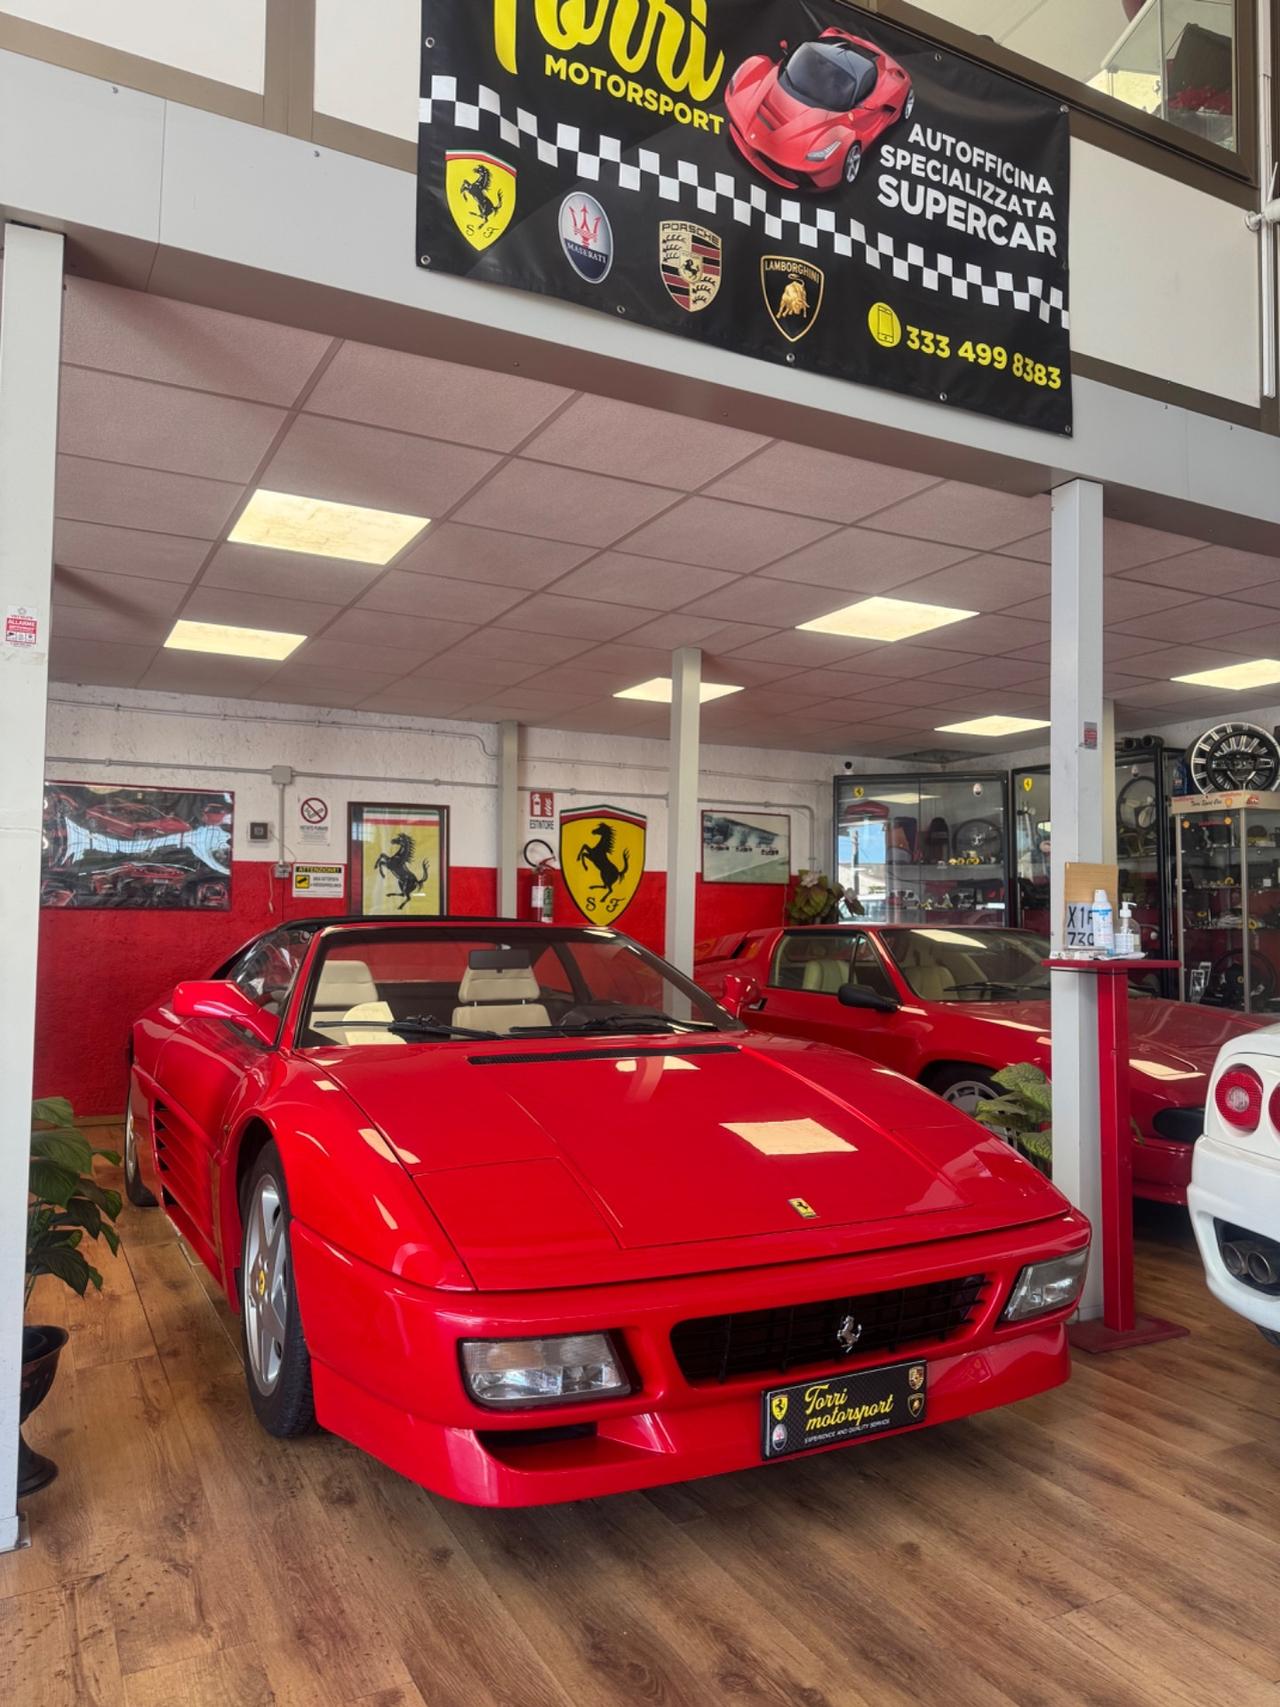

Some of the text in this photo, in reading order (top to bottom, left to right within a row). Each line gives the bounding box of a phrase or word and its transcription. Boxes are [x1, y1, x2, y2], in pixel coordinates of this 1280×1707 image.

[544, 54, 725, 135] MOTORSPORT
[879, 144, 1056, 221] SPECIALIZZATA
[908, 123, 1054, 196] AUTOFFICINA
[661, 222, 720, 245] PORSCHE
[877, 174, 1058, 258] SUPERCAR
[566, 241, 608, 264] MASERATI
[764, 260, 820, 285] LAMBORGHINI
[906, 324, 1062, 390] 333 499 8383
[804, 1383, 848, 1415] Torri
[805, 1394, 894, 1431] motorsport
